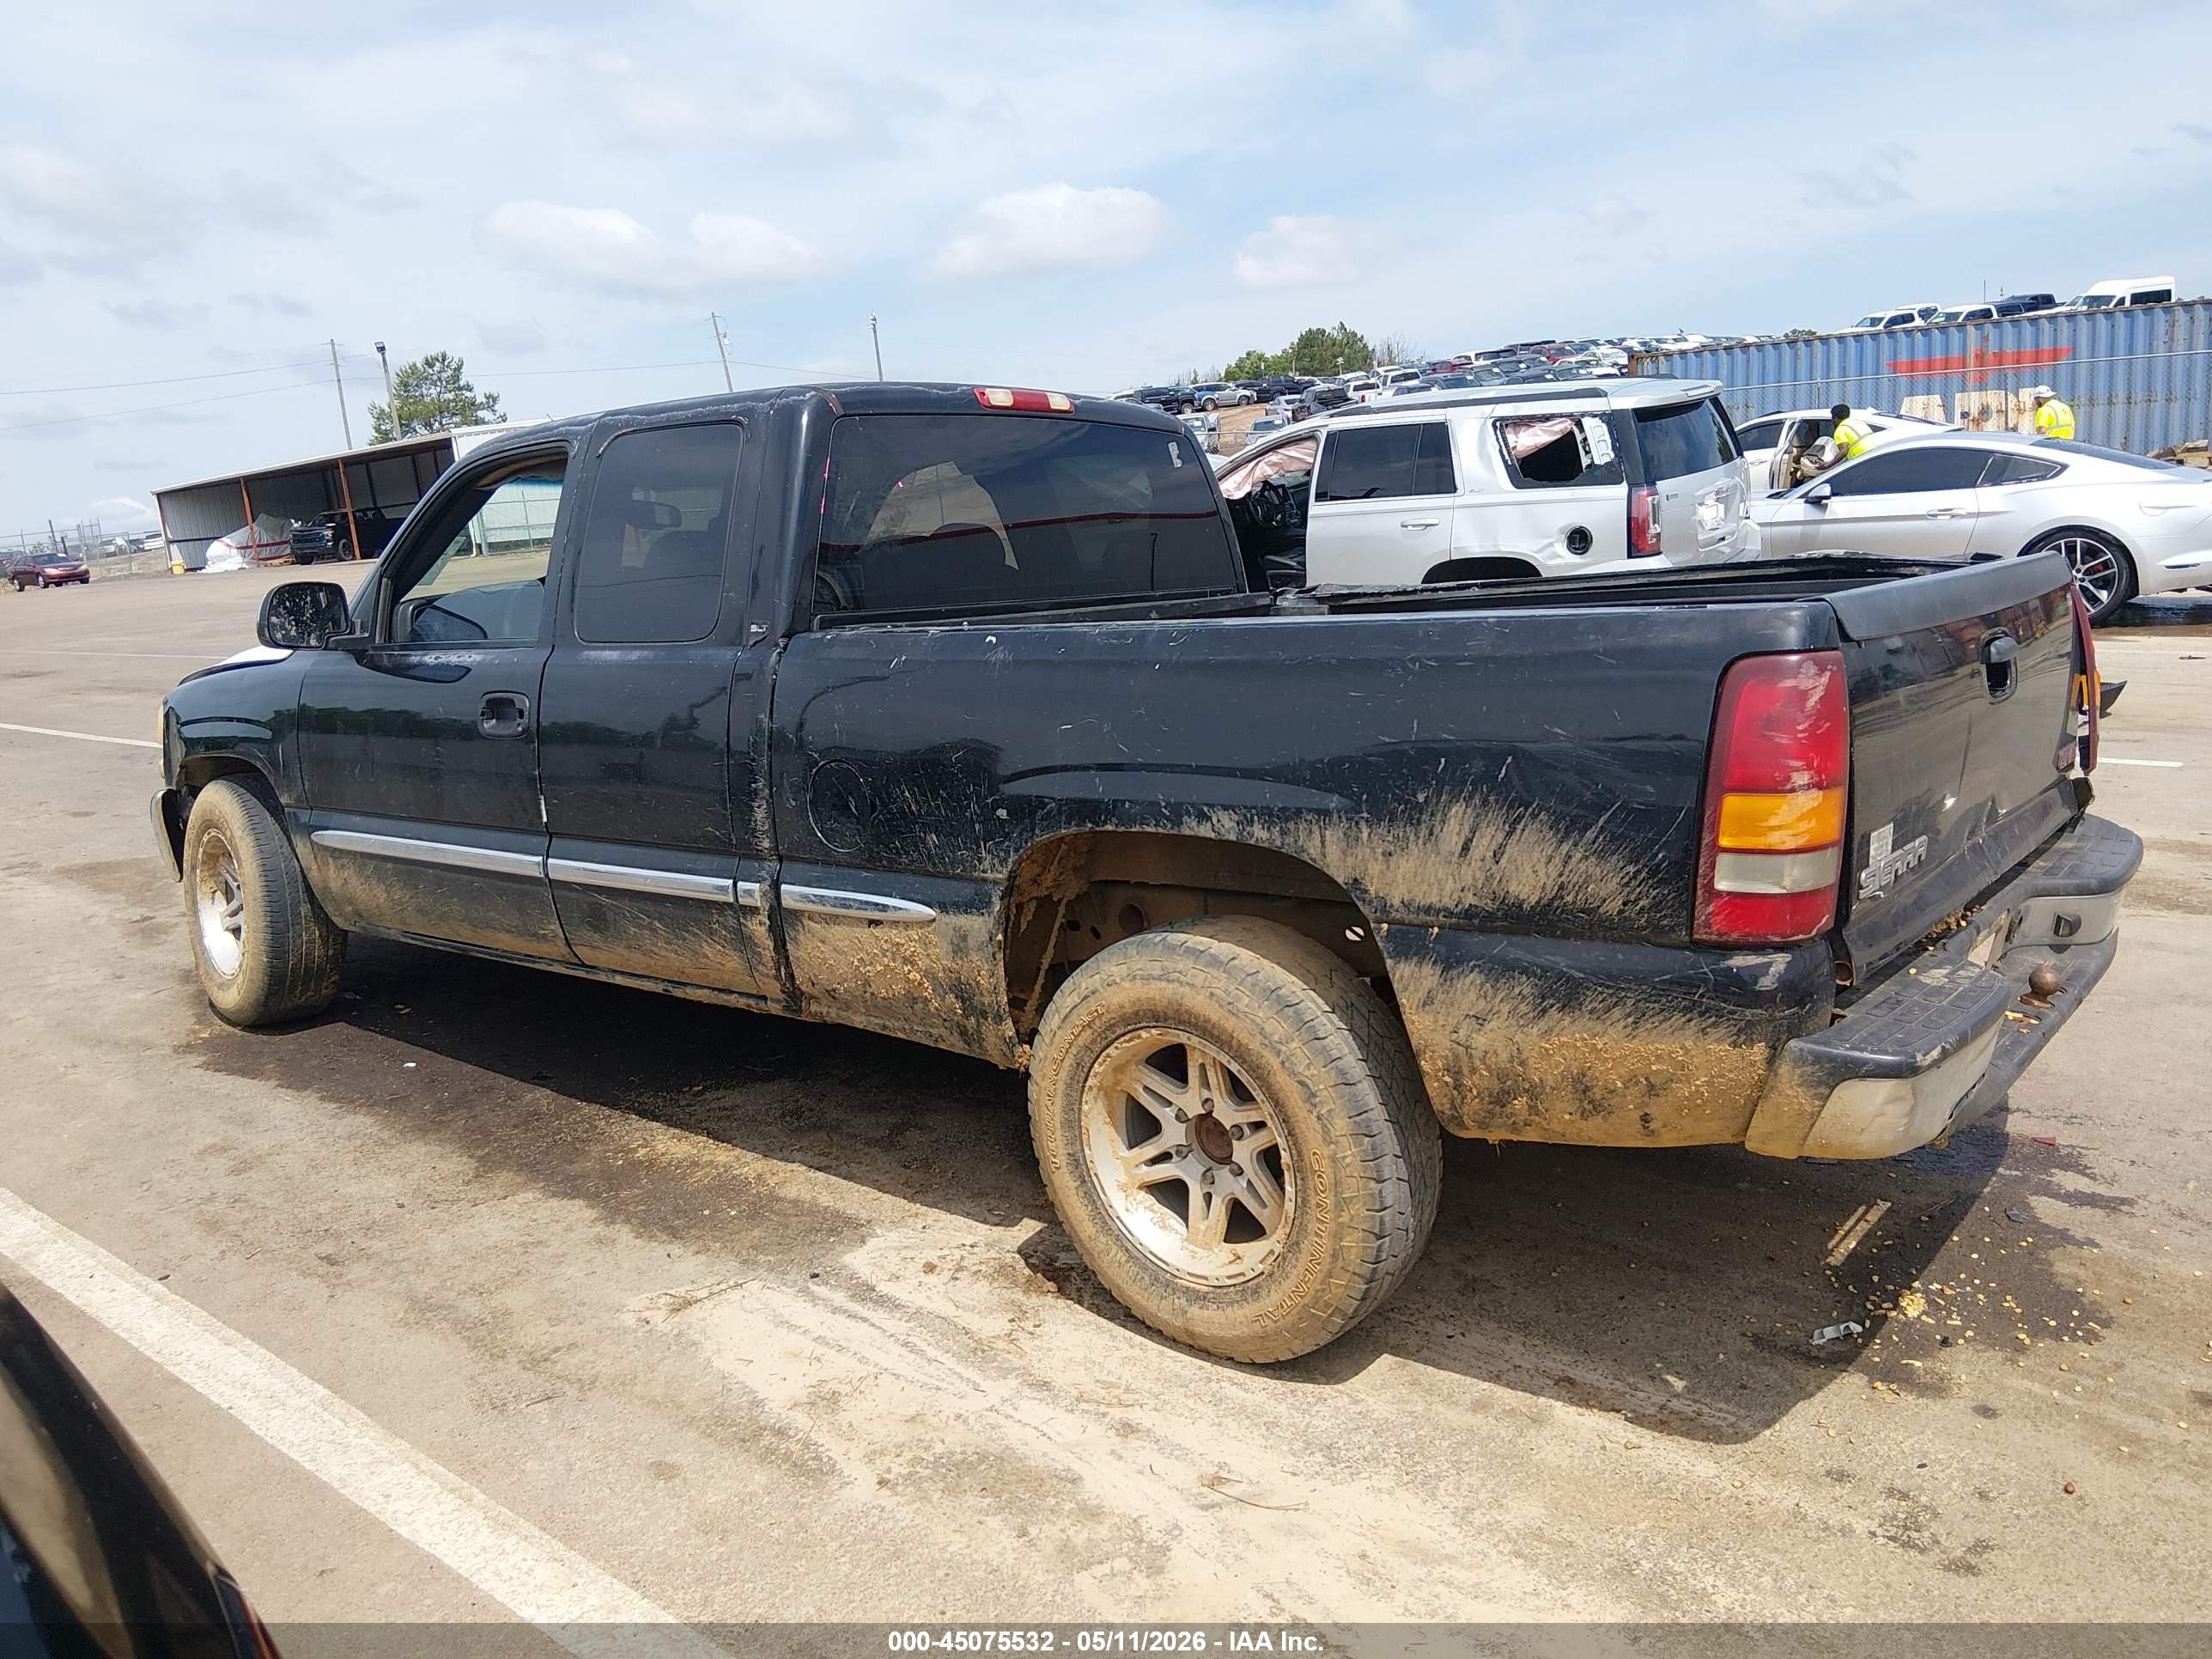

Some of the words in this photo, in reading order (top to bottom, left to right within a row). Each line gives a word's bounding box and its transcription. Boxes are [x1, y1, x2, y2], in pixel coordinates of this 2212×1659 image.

[750, 623, 769, 633] SLT
[1858, 834, 1928, 900] SIERRA
[1250, 1148, 1331, 1328] CONTINENTAL
